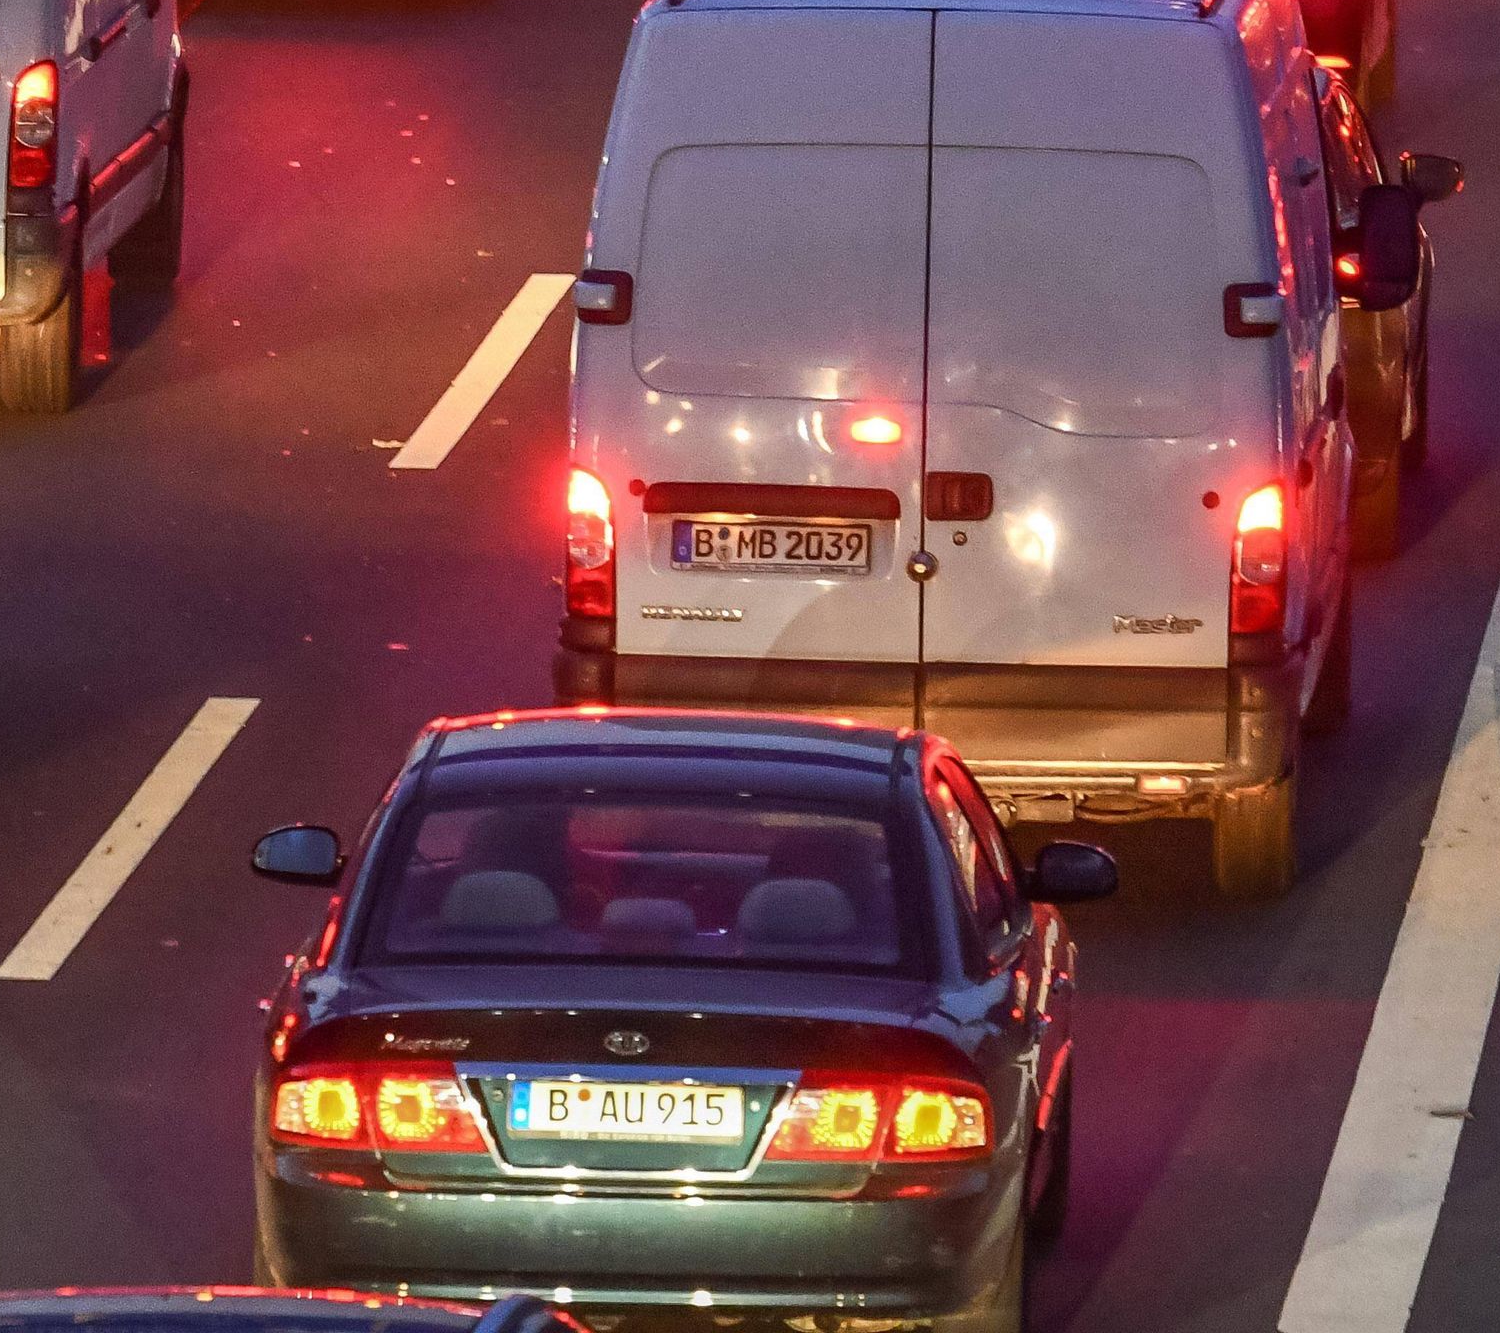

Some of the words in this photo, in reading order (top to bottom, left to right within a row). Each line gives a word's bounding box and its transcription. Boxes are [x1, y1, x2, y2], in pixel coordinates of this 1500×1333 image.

[694, 528, 713, 558] B
[736, 529, 777, 559] MB
[784, 530, 863, 562] 2039
[548, 1089, 569, 1123] B
[599, 1090, 645, 1125] AU
[657, 1092, 726, 1127] 915
